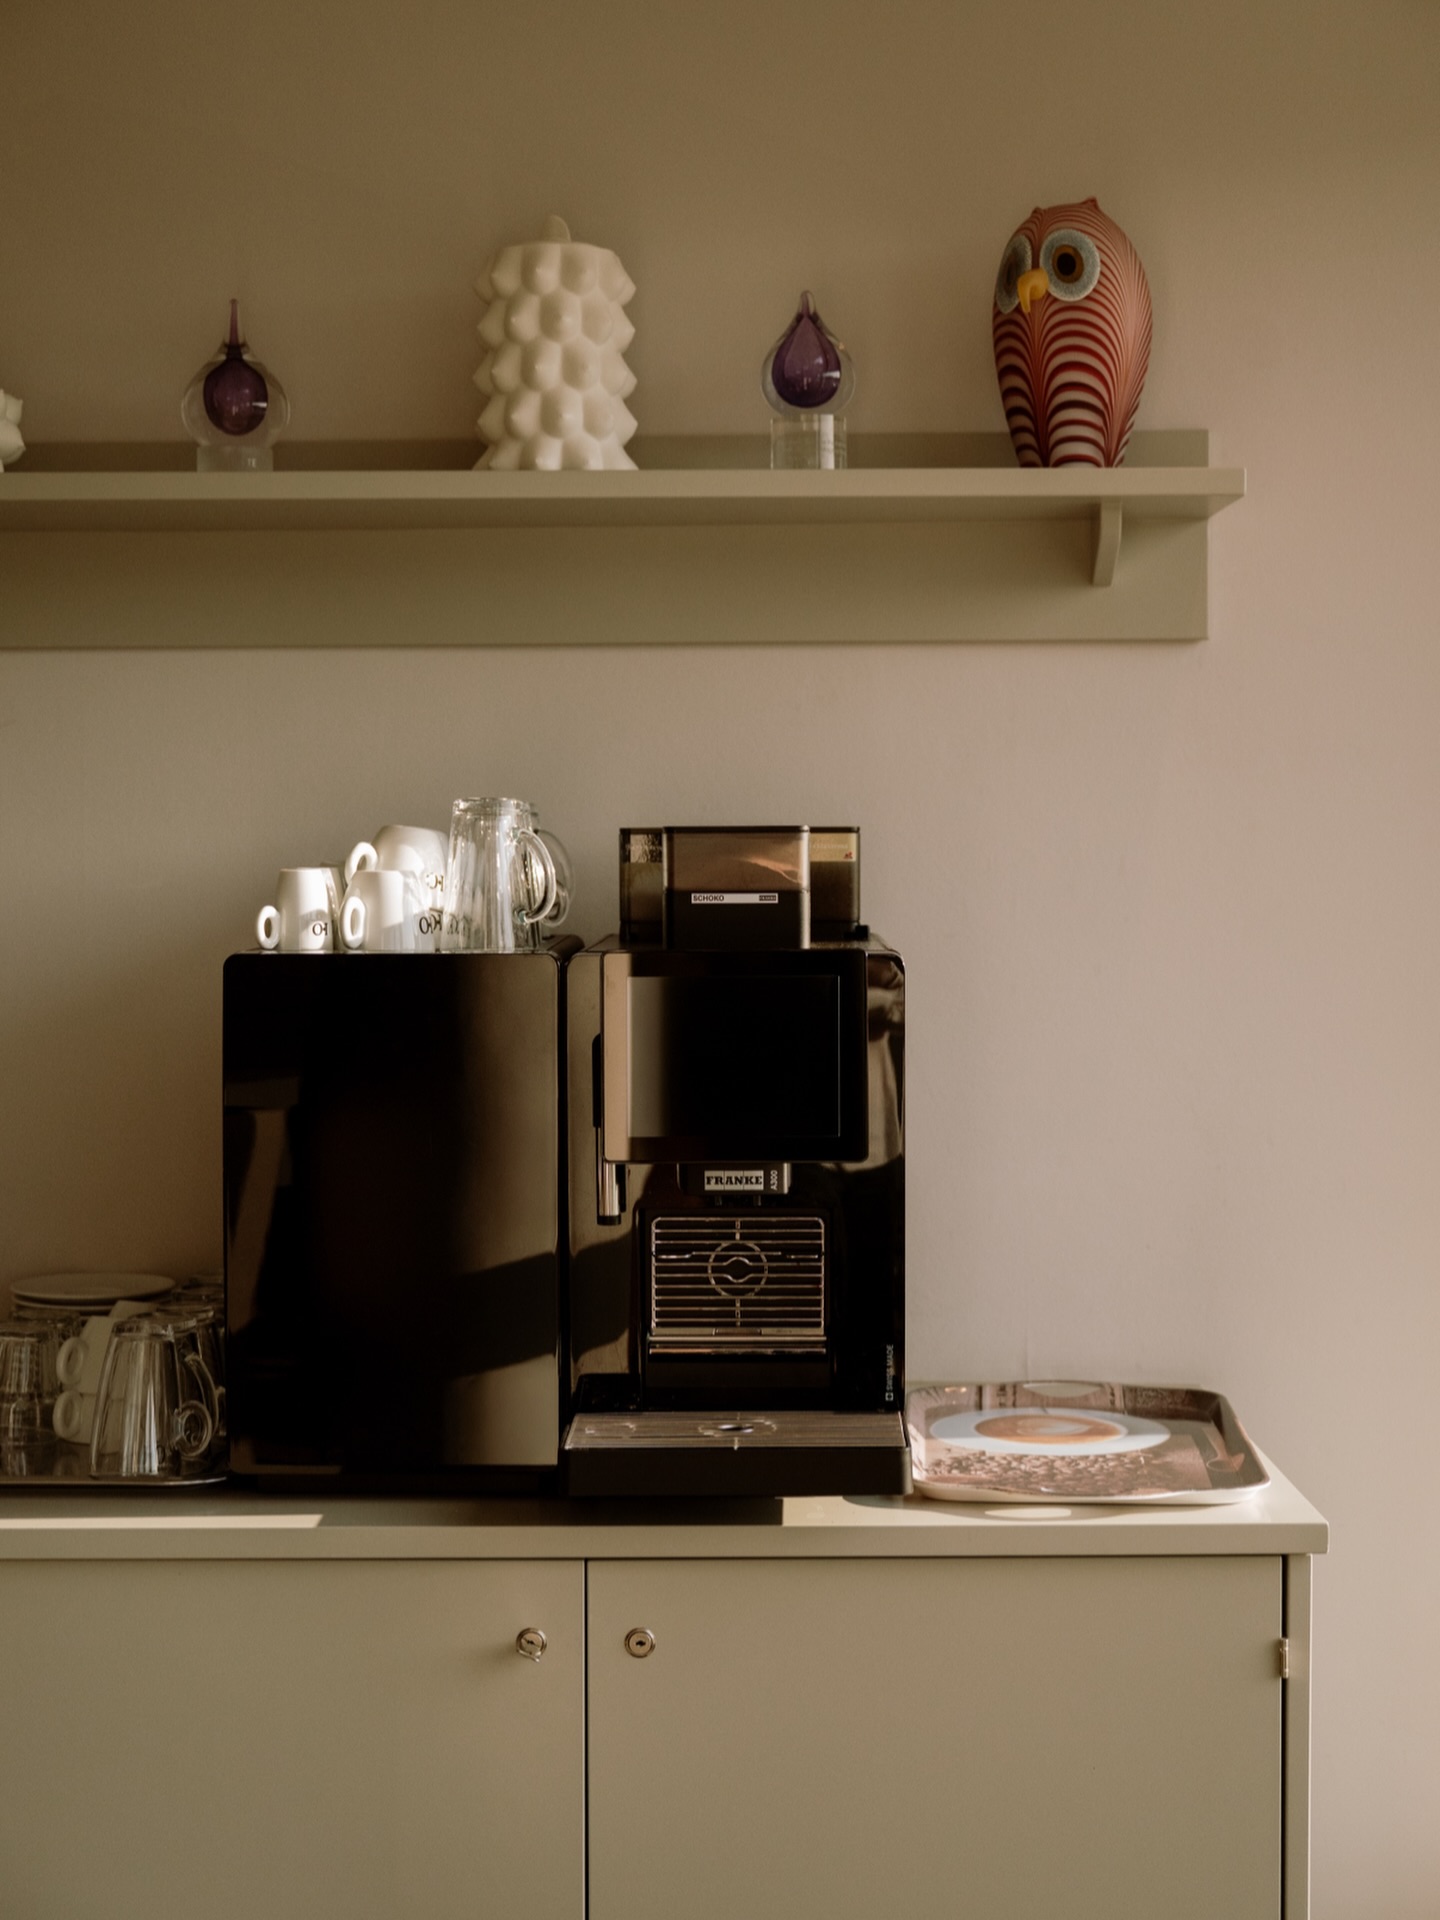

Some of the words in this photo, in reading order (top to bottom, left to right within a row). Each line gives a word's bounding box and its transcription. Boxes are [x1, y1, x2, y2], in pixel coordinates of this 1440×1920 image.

[693, 894, 725, 902] SCHOKO
[705, 1175, 763, 1186] FRANKE
[769, 1169, 779, 1191] A300
[886, 1344, 894, 1366] MADE
